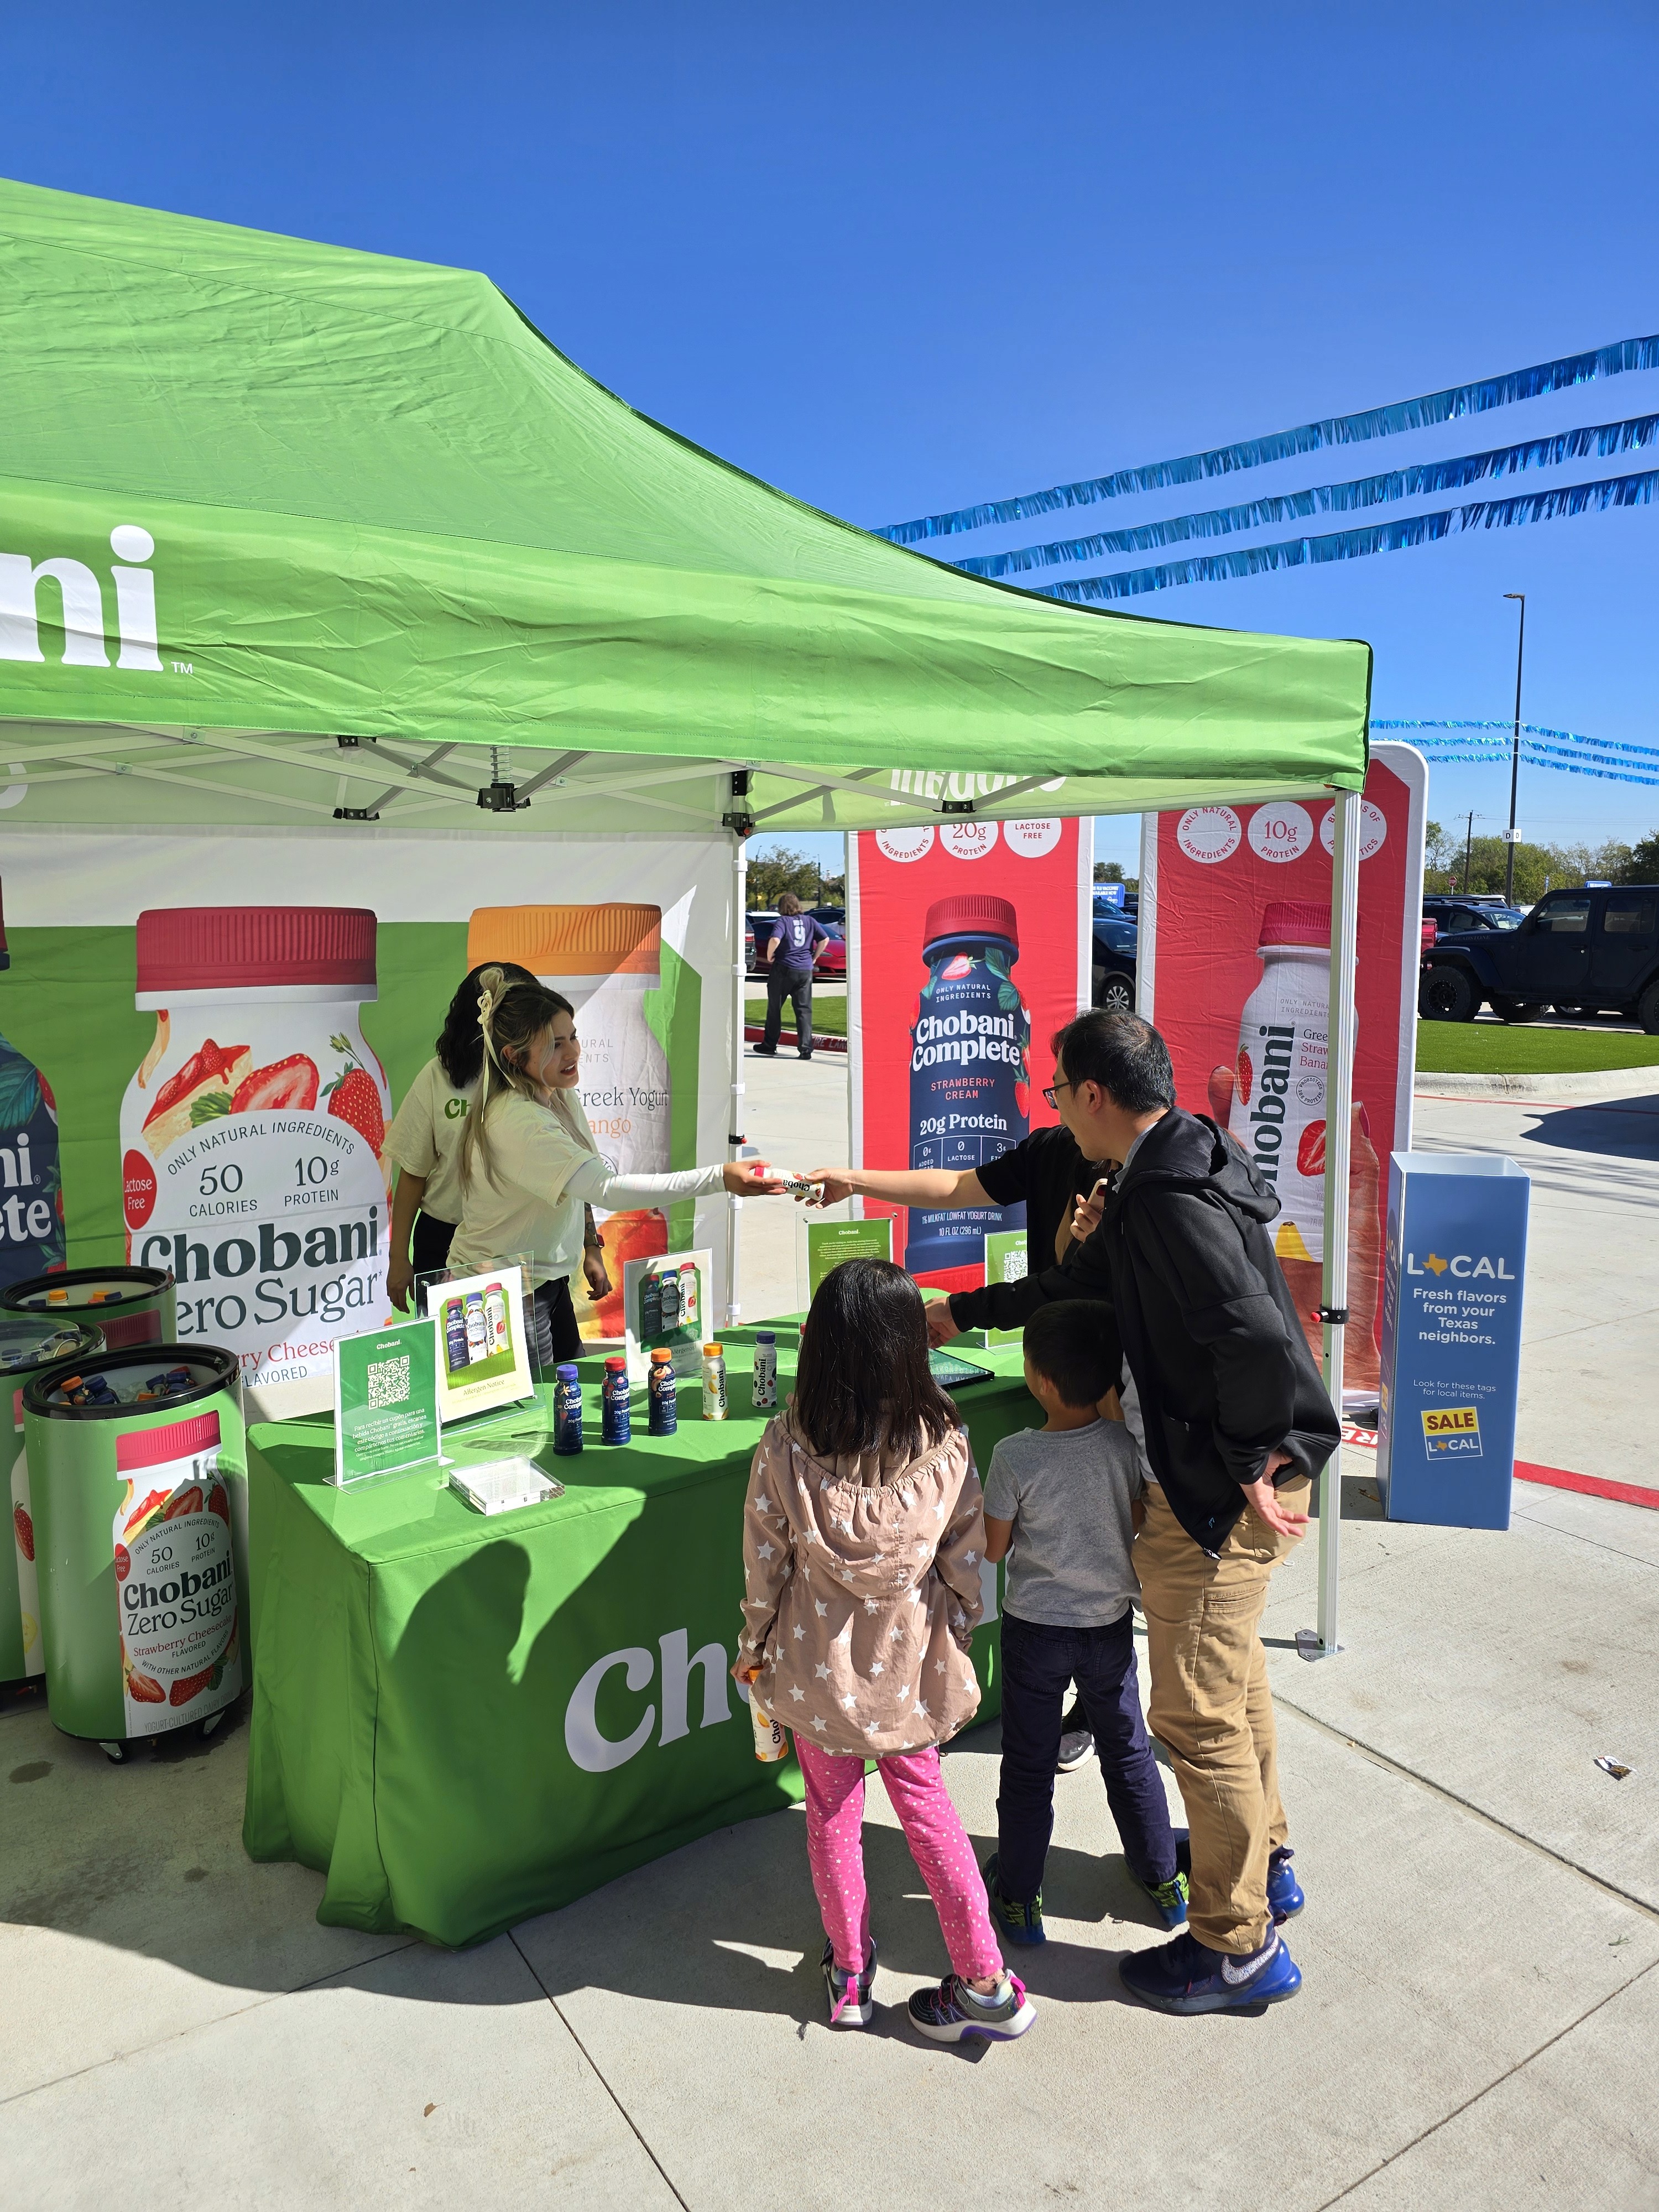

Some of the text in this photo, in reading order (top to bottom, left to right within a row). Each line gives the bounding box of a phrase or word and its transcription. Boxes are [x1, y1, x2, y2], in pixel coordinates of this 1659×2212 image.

[1015, 822, 1051, 831] LACTOSE
[1182, 807, 1237, 831] ONLY NATURAL
[1369, 811, 1380, 823] OF
[952, 822, 987, 841] 20g
[1264, 820, 1297, 842] 10g
[881, 838, 930, 859] INGREDIENTS
[952, 843, 987, 855] PROTEIN
[1183, 838, 1235, 859] INGREDIENTS
[1260, 845, 1300, 858] PROTEIN
[794, 925, 806, 947] 9
[936, 985, 954, 994] ONLY
[936, 992, 991, 1003] INGREDIENTS
[1302, 1000, 1329, 1009] NATURA
[916, 1010, 1014, 1045] Chobani
[1303, 1029, 1328, 1041] Gree
[912, 1036, 1020, 1072] Complete
[931, 1077, 995, 1092] STRAWBERRY
[1299, 1077, 1323, 1091] PROBIOTICS
[575, 1086, 668, 1111] reek Yogurt
[945, 1090, 979, 1100] CREAM
[1304, 1092, 1322, 1104] PROTEIN
[1250, 1025, 1295, 1194] hobani
[587, 1117, 632, 1139] ango
[920, 1113, 1008, 1136] 20g Protein
[168, 1121, 354, 1176] ONLY NATURAL INGREDIENTS
[295, 1156, 340, 1187] 10g
[919, 1159, 934, 1168] ADDED
[199, 1164, 243, 1196] 50
[127, 1196, 145, 1211] Free
[284, 1188, 339, 1207] PROTEIN
[189, 1199, 258, 1217] CALORIES
[927, 1213, 946, 1224] MILKFAT
[946, 1212, 966, 1221] LOWFAT
[967, 1211, 987, 1220] YOGURT
[988, 1211, 1003, 1222] DRINK
[938, 1226, 982, 1237] 10 FL OZ (296 mL)
[140, 1205, 378, 1284] Chobani
[1413, 1288, 1507, 1303] Fresh flavors
[177, 1294, 247, 1336] ero
[1423, 1302, 1495, 1317] from your
[486, 1306, 495, 1345] Chobani
[1438, 1317, 1478, 1329] Texas
[376, 1339, 401, 1350] Chobani
[1419, 1330, 1496, 1344] neighbors.
[242, 1365, 307, 1387] LAVORED
[758, 1358, 767, 1396] Chobani
[1413, 1379, 1435, 1387] Look
[1452, 1382, 1475, 1390] these
[1477, 1384, 1496, 1392] tags
[463, 1385, 486, 1396] Allergen
[487, 1379, 505, 1389] Notice
[717, 1369, 725, 1408] Chobani
[1437, 1389, 1457, 1397] local
[1460, 1390, 1485, 1399] items.
[352, 1431, 369, 1439] bebida
[393, 1420, 408, 1430] gratis,
[408, 1415, 427, 1423] escanea
[366, 1420, 382, 1429] recibir
[389, 1413, 404, 1423] cupón
[404, 1411, 415, 1419] para
[1426, 1412, 1474, 1431] SALE
[354, 1440, 387, 1452] compártenos
[395, 1430, 425, 1441] comentarios.
[368, 1433, 384, 1442] código
[388, 1423, 419, 1436] continuación
[135, 1518, 220, 1554] ONLY NATURAL INGREDIENTS
[195, 1531, 215, 1551] 10g
[151, 1546, 173, 1564] 50
[191, 1547, 215, 1563] PROTEIN
[117, 1564, 126, 1573] Free
[147, 1561, 180, 1575] CALORIES
[124, 1550, 231, 1611] Chobani
[127, 1585, 233, 1636] Zero Sugar
[133, 1614, 232, 1657] Strawberry Cheesecake
[141, 1629, 229, 1675] WITH OTHER NATURAL FLAVORS
[171, 1640, 206, 1658] FLAVORED
[565, 1627, 749, 1772] Ch
[144, 1707, 202, 1733] YOGURT-CULTURED
[204, 1699, 221, 1715] DAIRY
